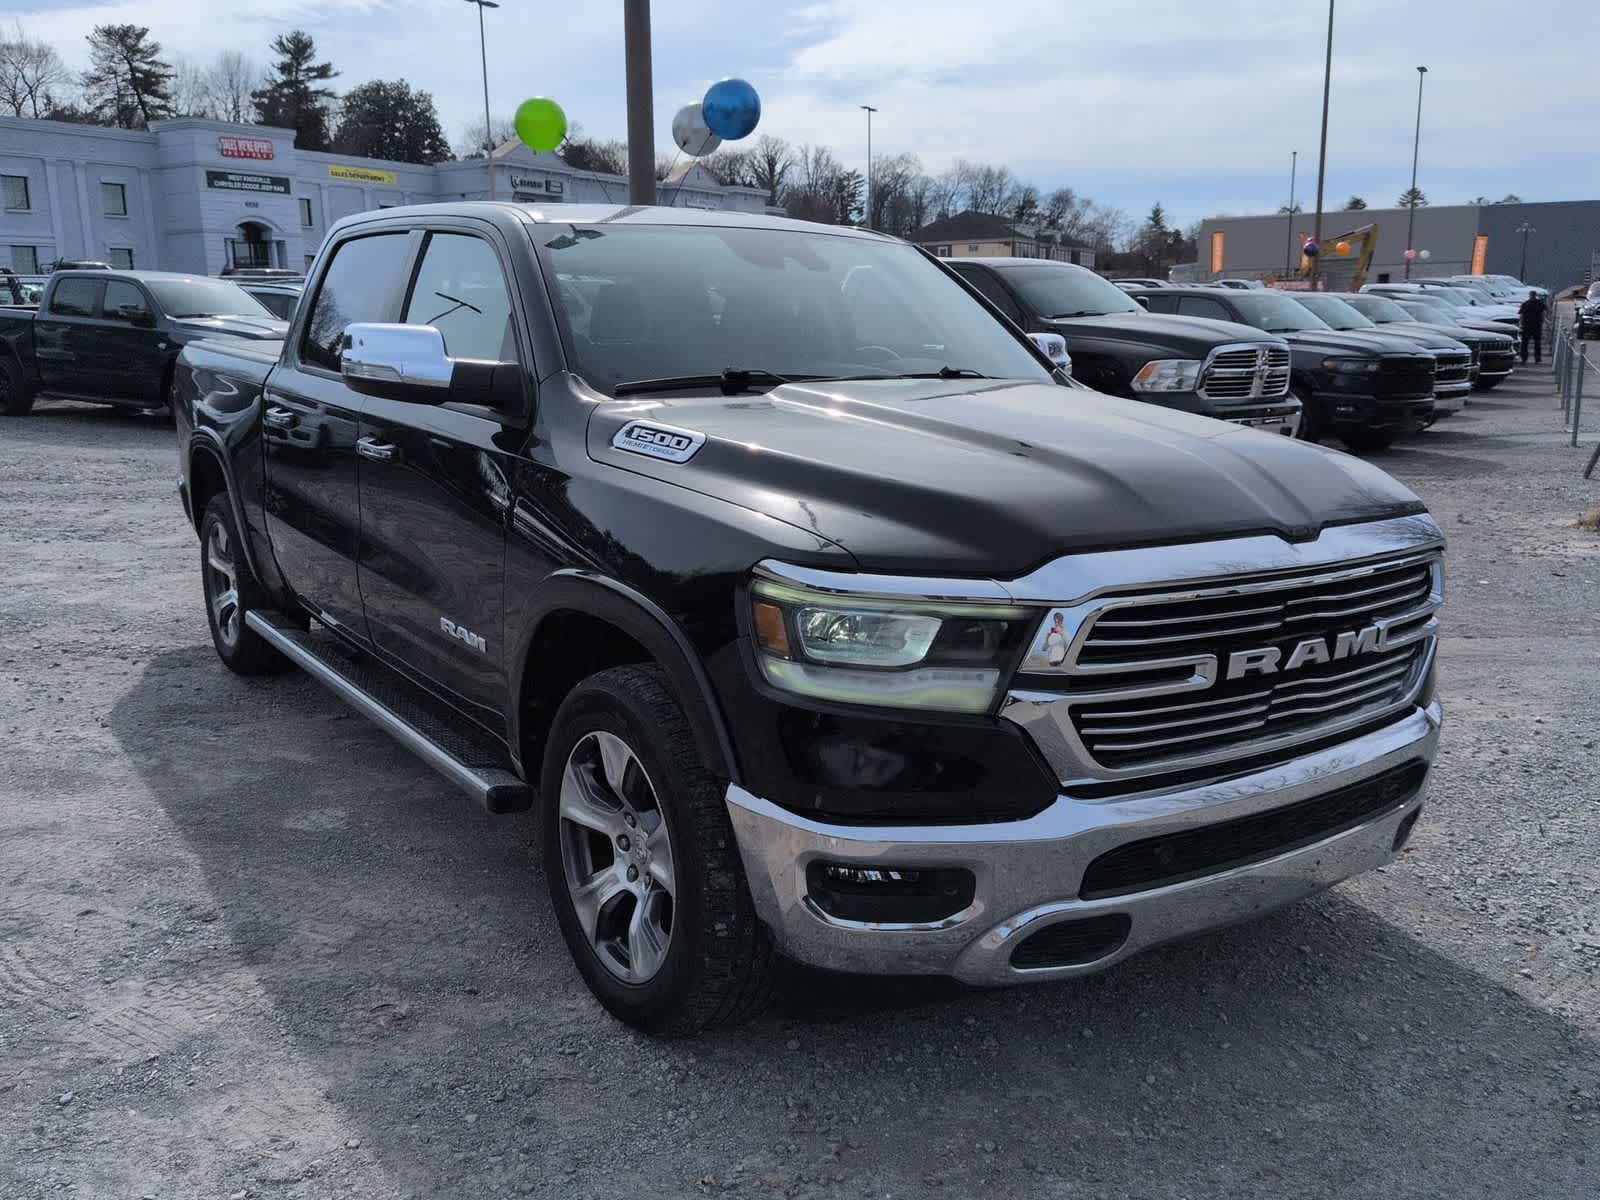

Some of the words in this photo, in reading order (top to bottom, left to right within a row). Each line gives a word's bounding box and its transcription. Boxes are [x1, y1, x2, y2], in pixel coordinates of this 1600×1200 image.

[631, 427, 690, 450] 1500
[439, 616, 487, 654] RAM
[1226, 625, 1378, 680] RAM
